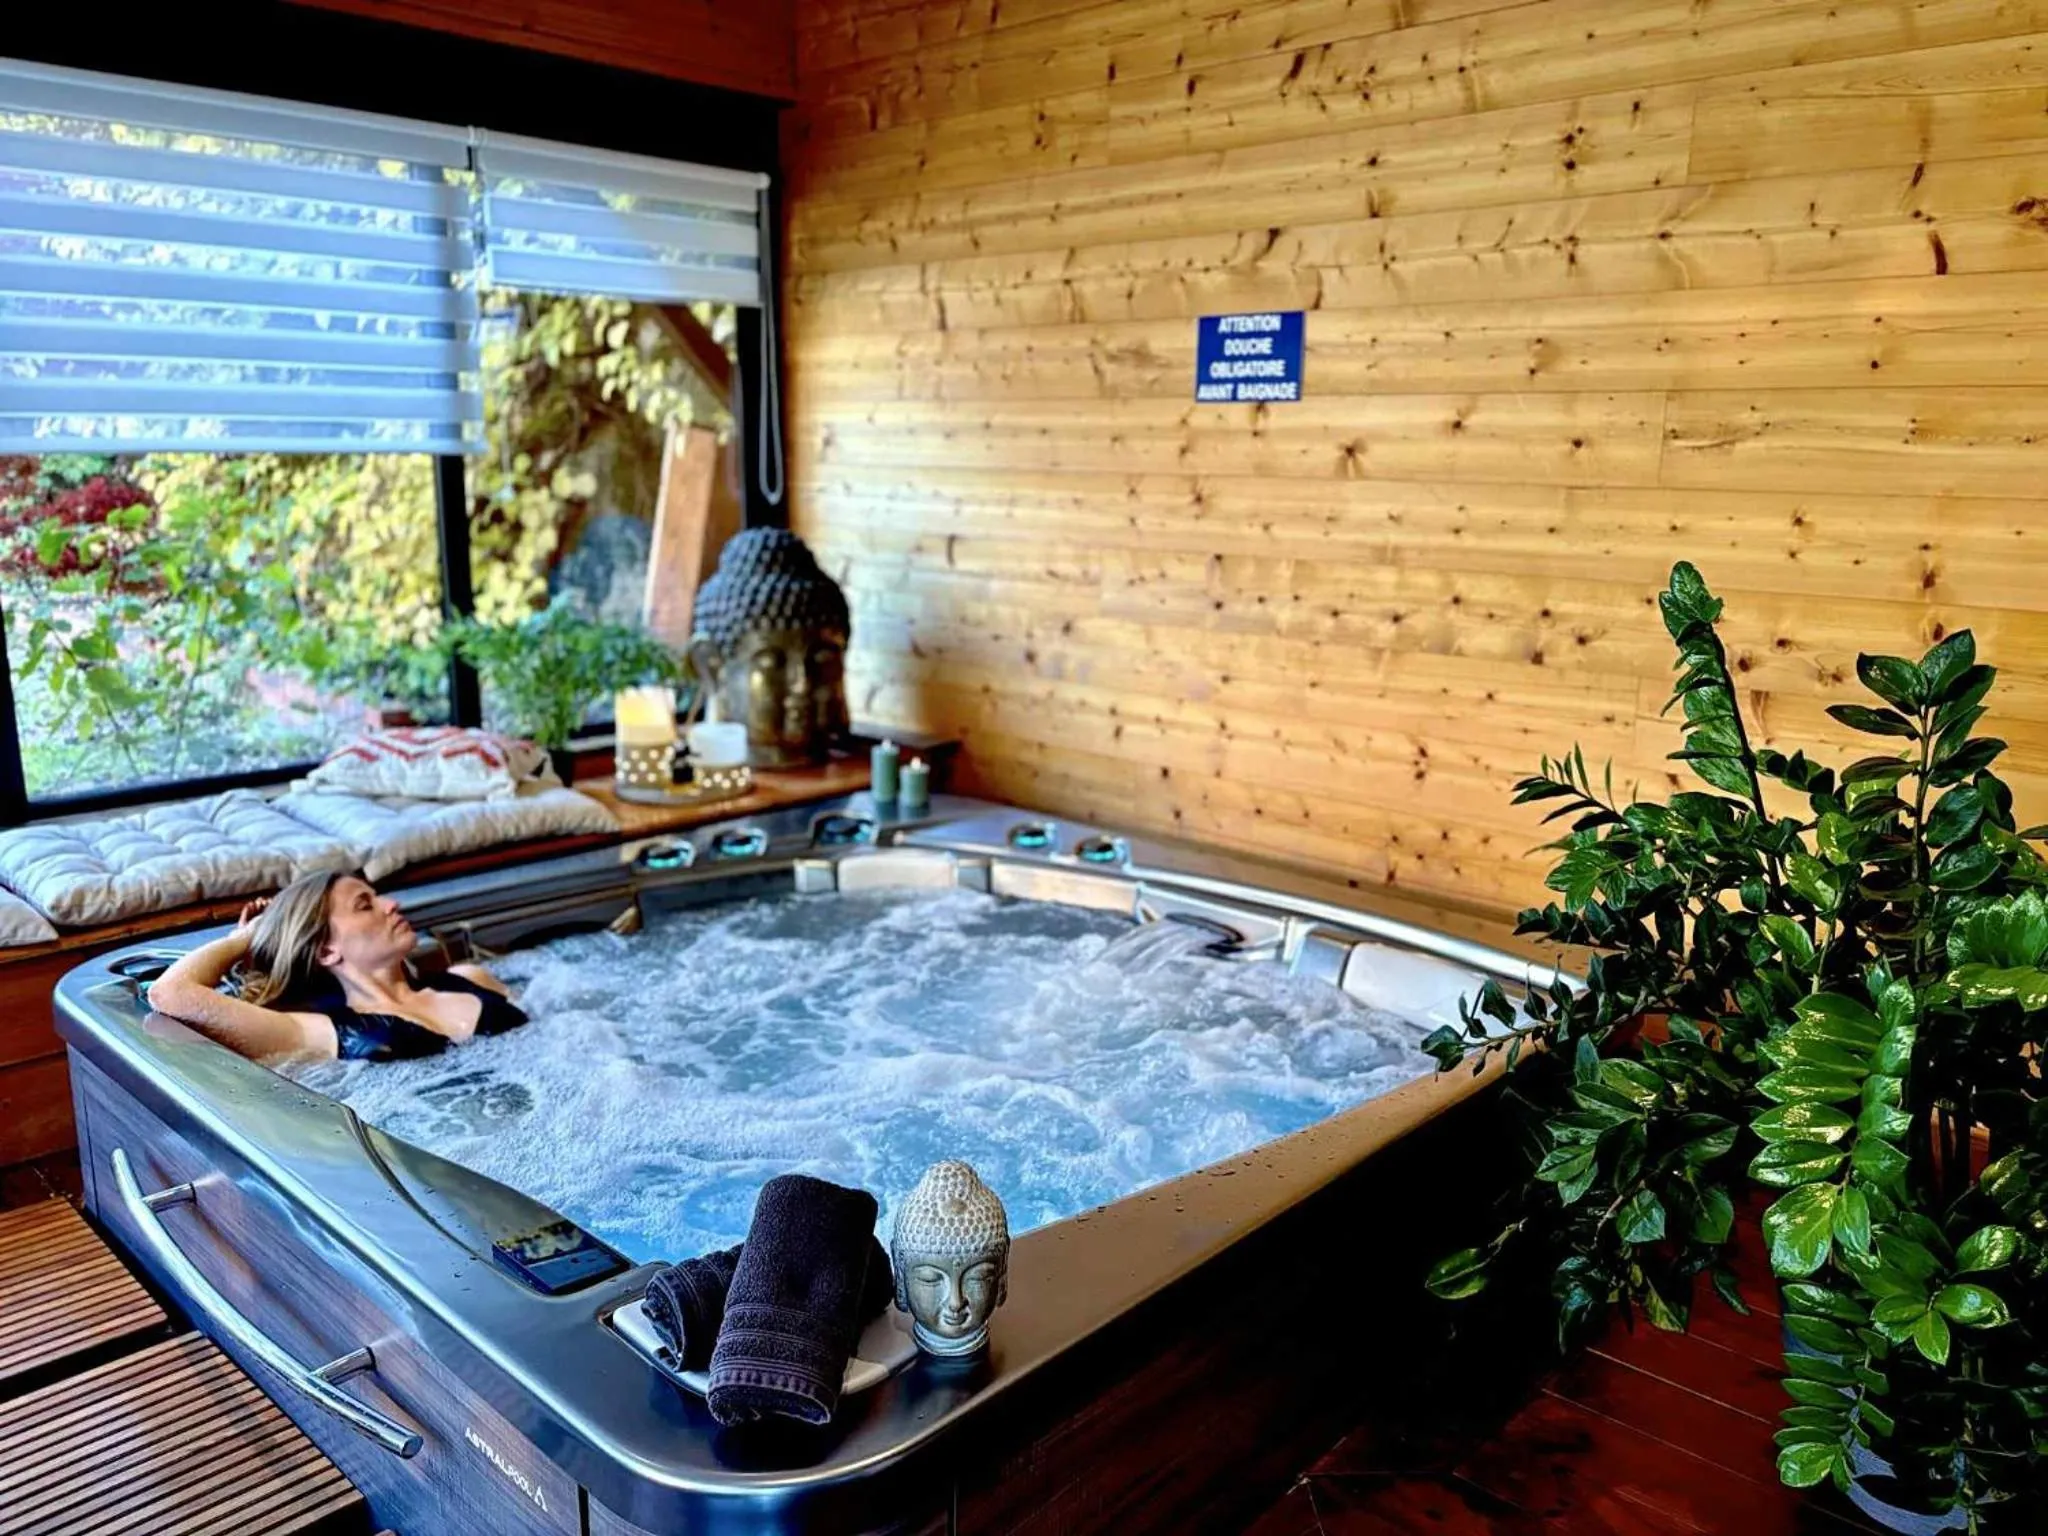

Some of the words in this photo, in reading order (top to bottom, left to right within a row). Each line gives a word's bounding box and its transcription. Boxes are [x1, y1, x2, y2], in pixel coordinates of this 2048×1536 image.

[1218, 314, 1282, 333] ATTENTION
[1224, 336, 1273, 356] DOUCHE
[1209, 359, 1286, 379] OBLIGATOIRE
[1198, 382, 1235, 400] AVANT
[1236, 381, 1298, 400] BAIGNADE
[464, 1426, 532, 1498] ASTRALPOOL
